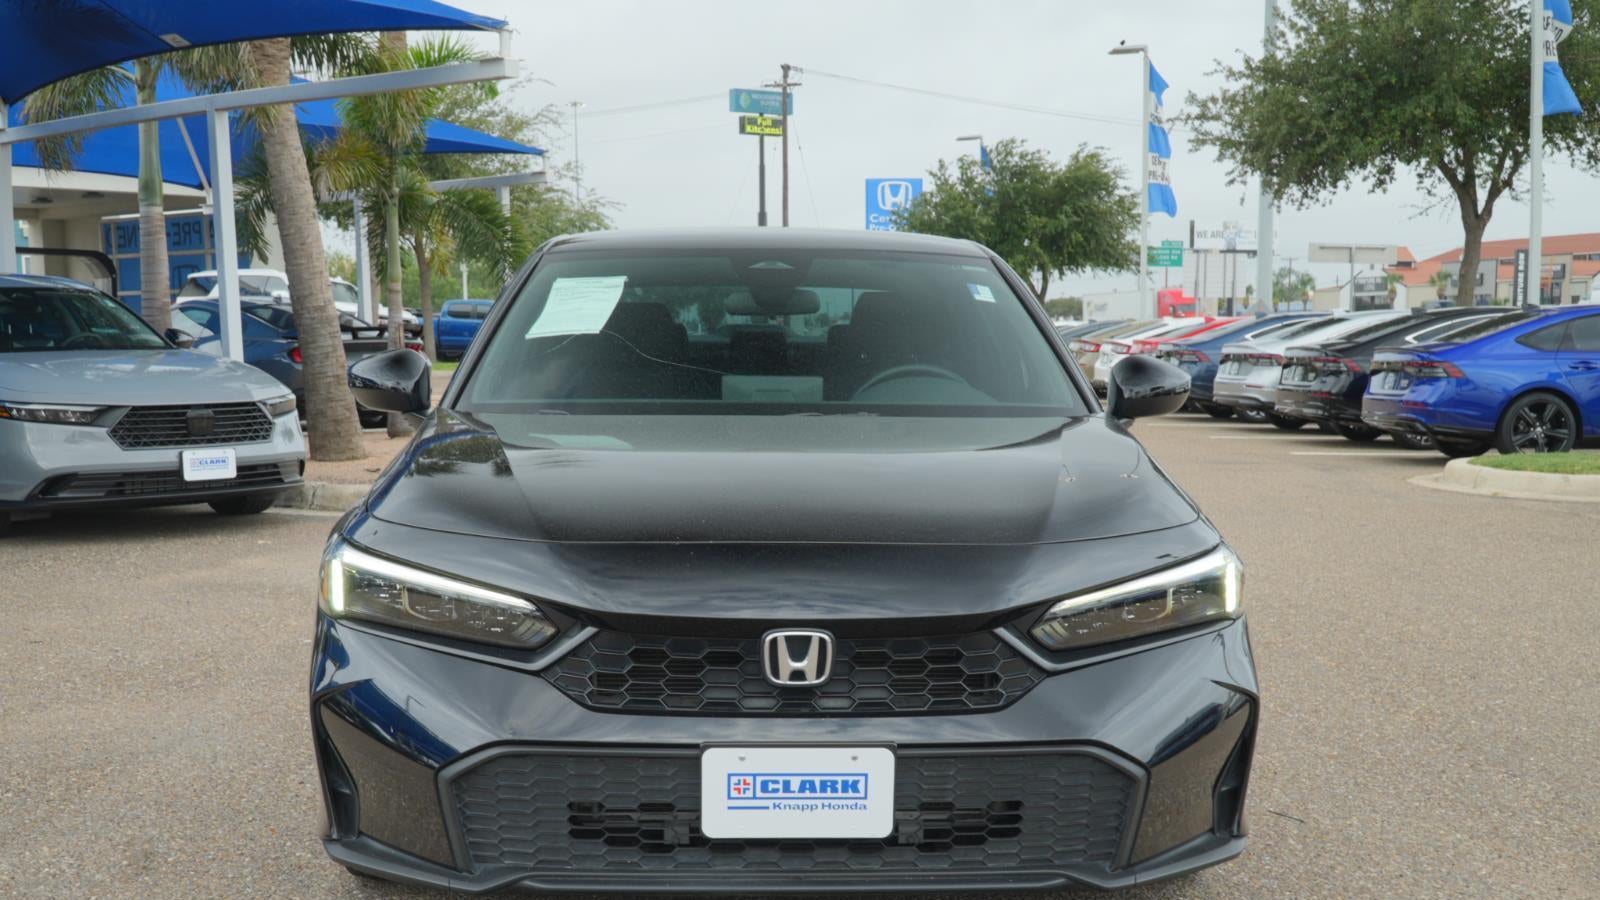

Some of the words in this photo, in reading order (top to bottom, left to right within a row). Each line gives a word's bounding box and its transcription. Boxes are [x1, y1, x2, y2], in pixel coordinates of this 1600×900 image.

[757, 117, 772, 126] Full
[1196, 230, 1208, 239] WE
[1210, 230, 1224, 240] ARE
[760, 779, 861, 794] CLARK
[772, 802, 819, 812] Knapp
[821, 802, 867, 811] Honda
